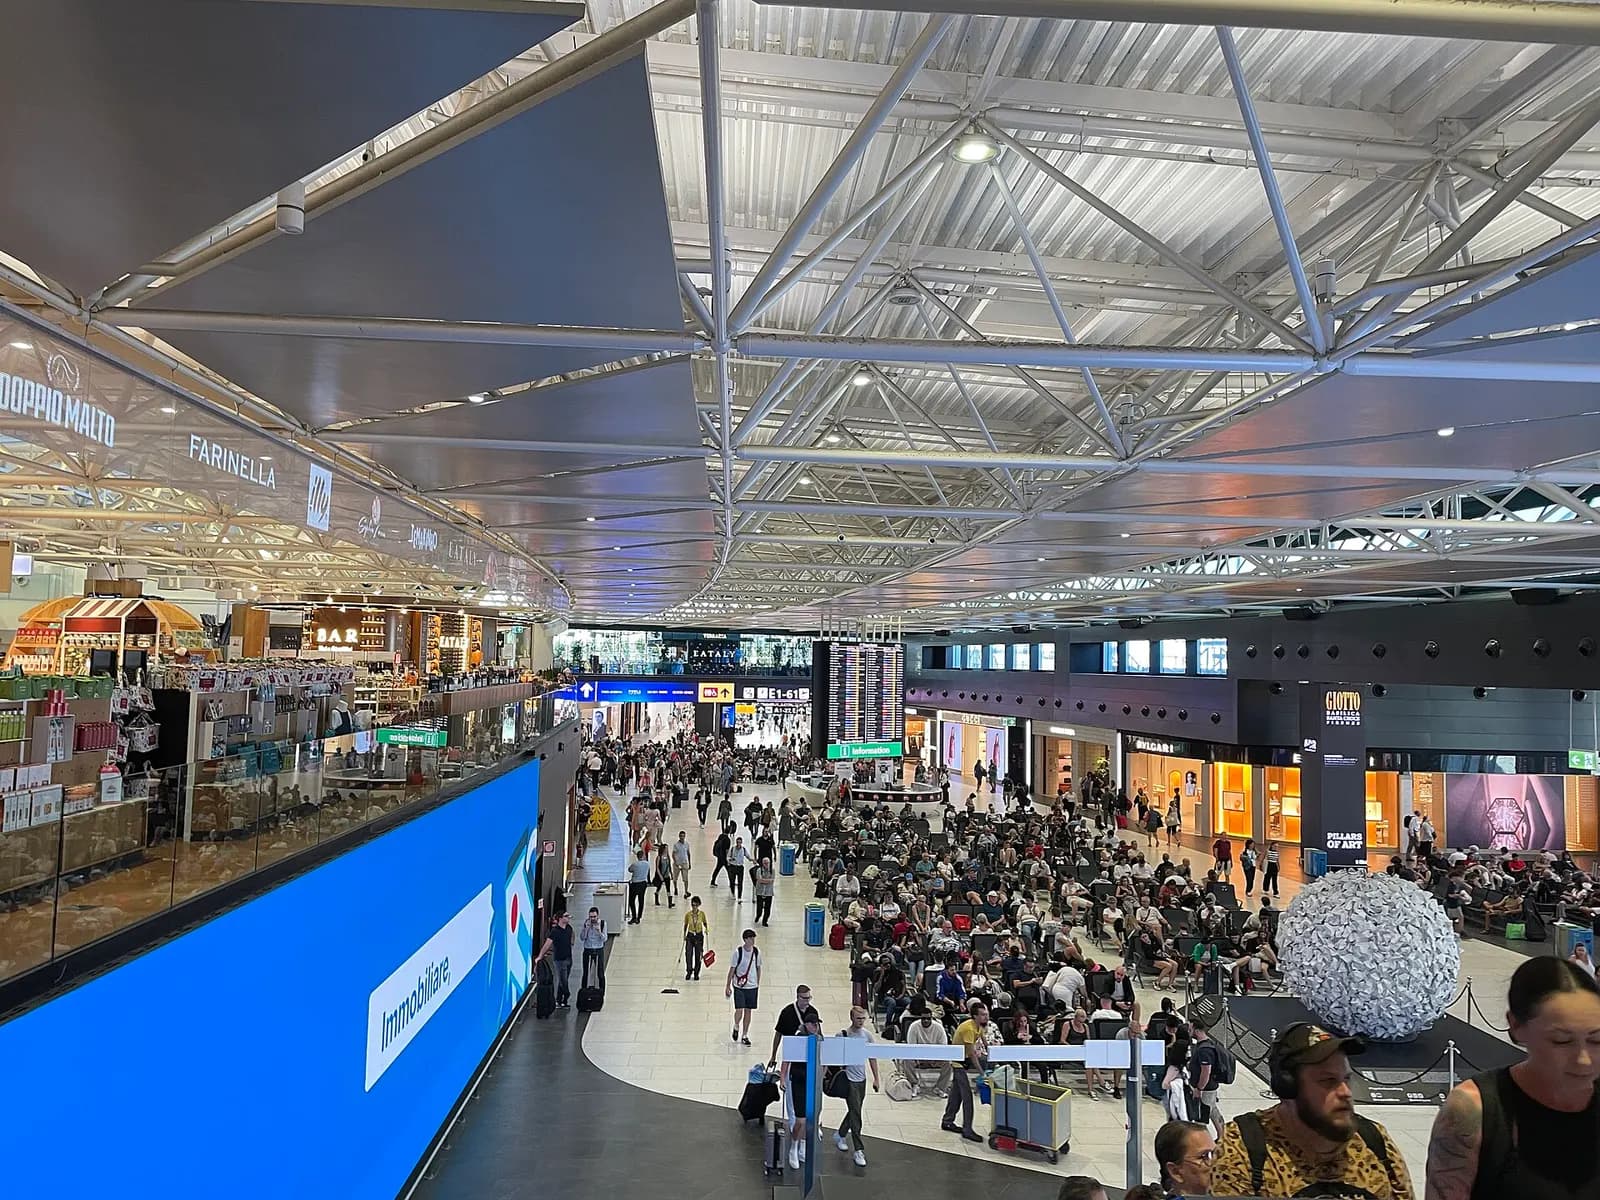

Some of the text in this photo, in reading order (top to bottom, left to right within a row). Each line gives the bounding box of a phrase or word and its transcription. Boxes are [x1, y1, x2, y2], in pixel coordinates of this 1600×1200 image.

[64, 394, 115, 448] MALTO
[189, 432, 276, 490] FARINELLA
[316, 628, 358, 643] BAR
[693, 650, 736, 658] EATALY
[768, 688, 798, 699] E1-61
[1326, 691, 1360, 710] GIOTTO
[961, 714, 981, 725] GUCCI
[1136, 739, 1174, 753] BVLGARI
[1327, 832, 1363, 841] PILLARS
[1327, 840, 1363, 849] OF ART
